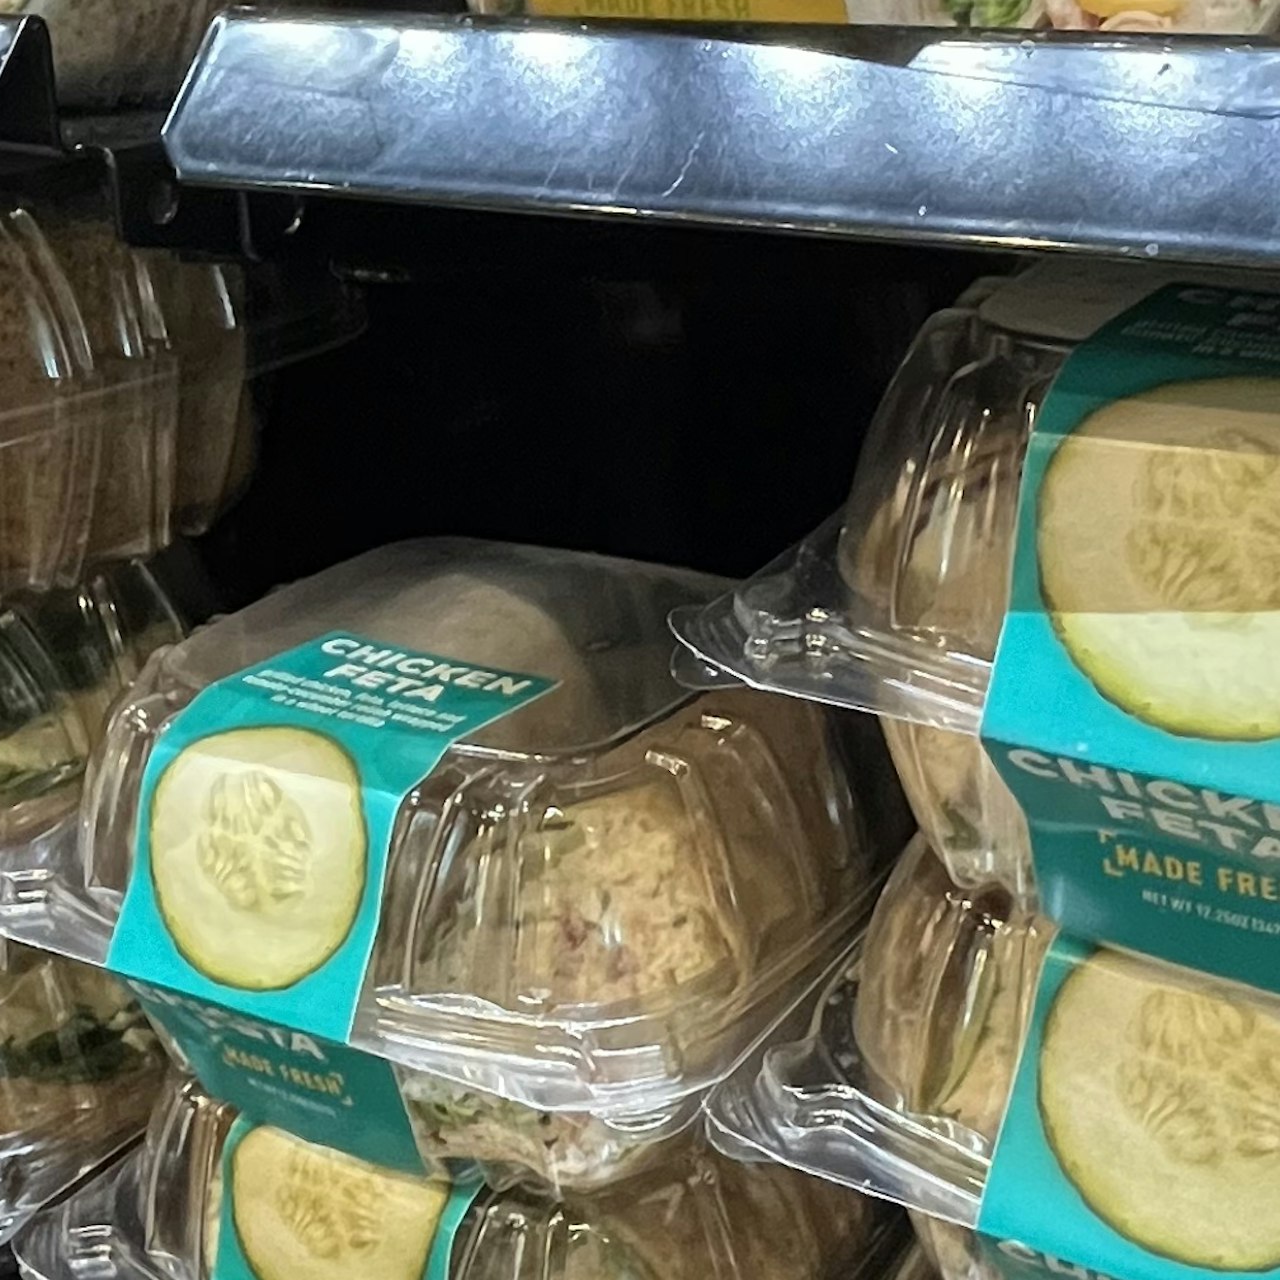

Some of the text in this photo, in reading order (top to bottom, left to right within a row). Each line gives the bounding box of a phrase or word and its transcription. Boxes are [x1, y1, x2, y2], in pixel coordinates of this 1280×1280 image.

[320, 638, 534, 696] CHICKEN
[322, 663, 445, 703] FETA
[1115, 843, 1203, 887] MADE
